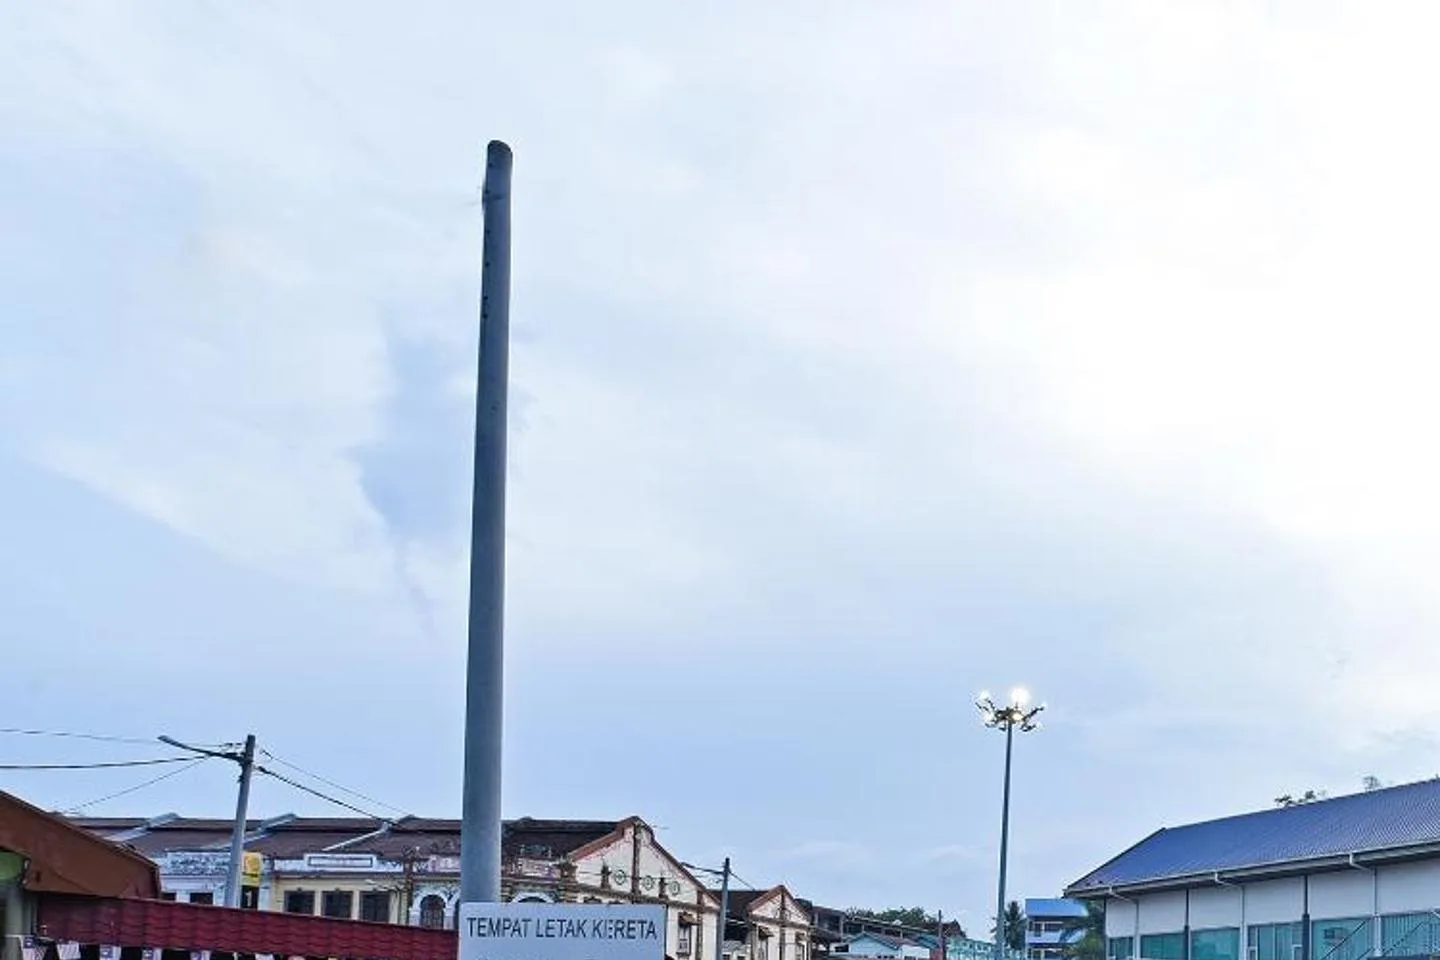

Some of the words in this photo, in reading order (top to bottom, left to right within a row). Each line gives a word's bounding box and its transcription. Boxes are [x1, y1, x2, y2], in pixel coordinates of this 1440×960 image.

[466, 917, 532, 938] TEMPAT
[535, 919, 588, 939] LETAK
[591, 919, 658, 940] KERETA
